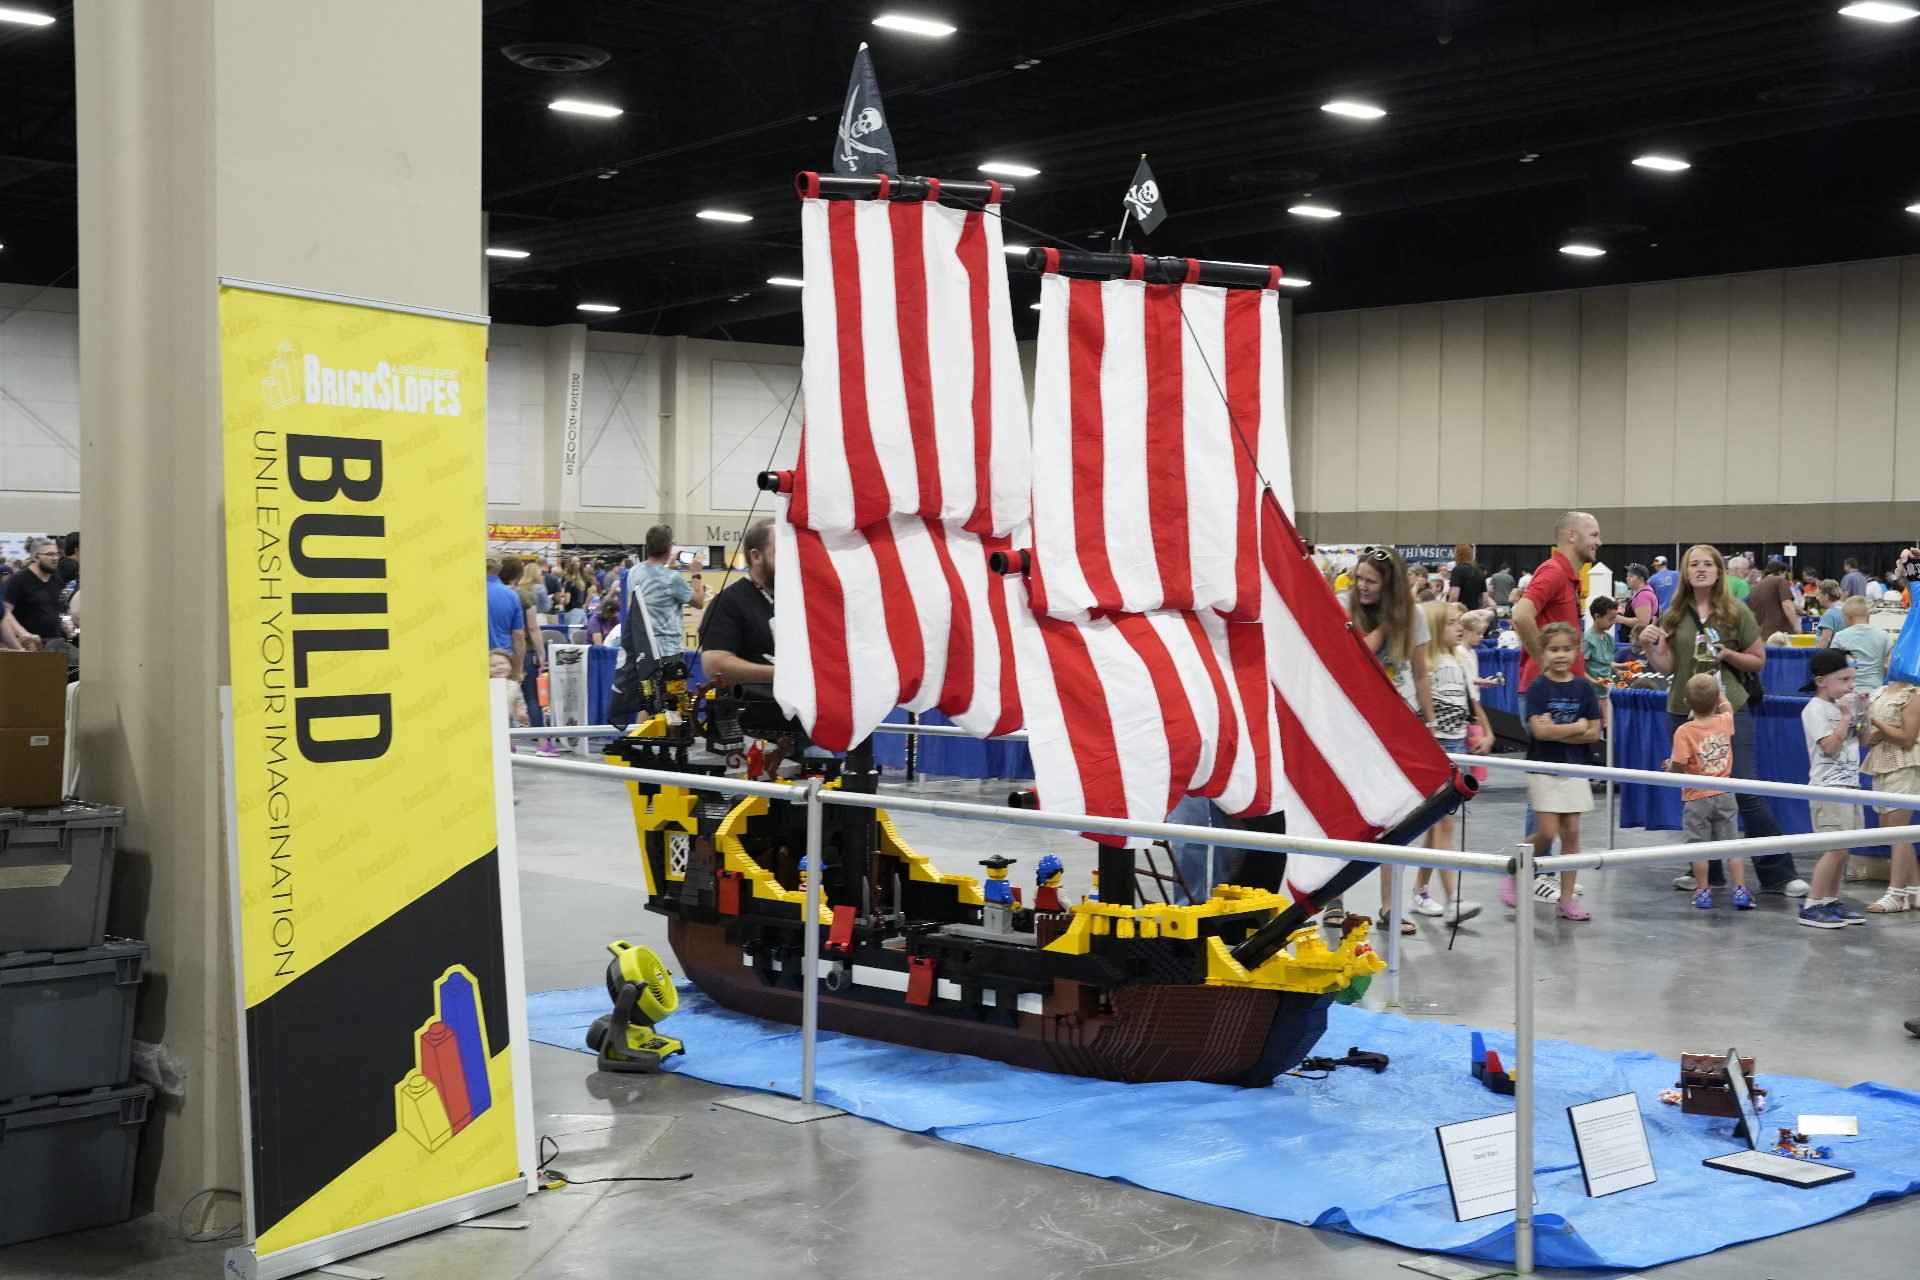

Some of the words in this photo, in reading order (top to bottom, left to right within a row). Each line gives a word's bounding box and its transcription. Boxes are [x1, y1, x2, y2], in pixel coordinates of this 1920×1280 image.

[399, 364, 418, 376] LEGO
[419, 366, 434, 377] FAN
[435, 368, 459, 380] EVENT
[564, 372, 581, 476] RESTROOMS
[253, 430, 283, 600] UNLEASH
[1398, 547, 1455, 559] WHIMSICA
[286, 432, 393, 764] BUILD
[261, 611, 287, 714] YOUR
[264, 725, 295, 977] IMAGINATION
